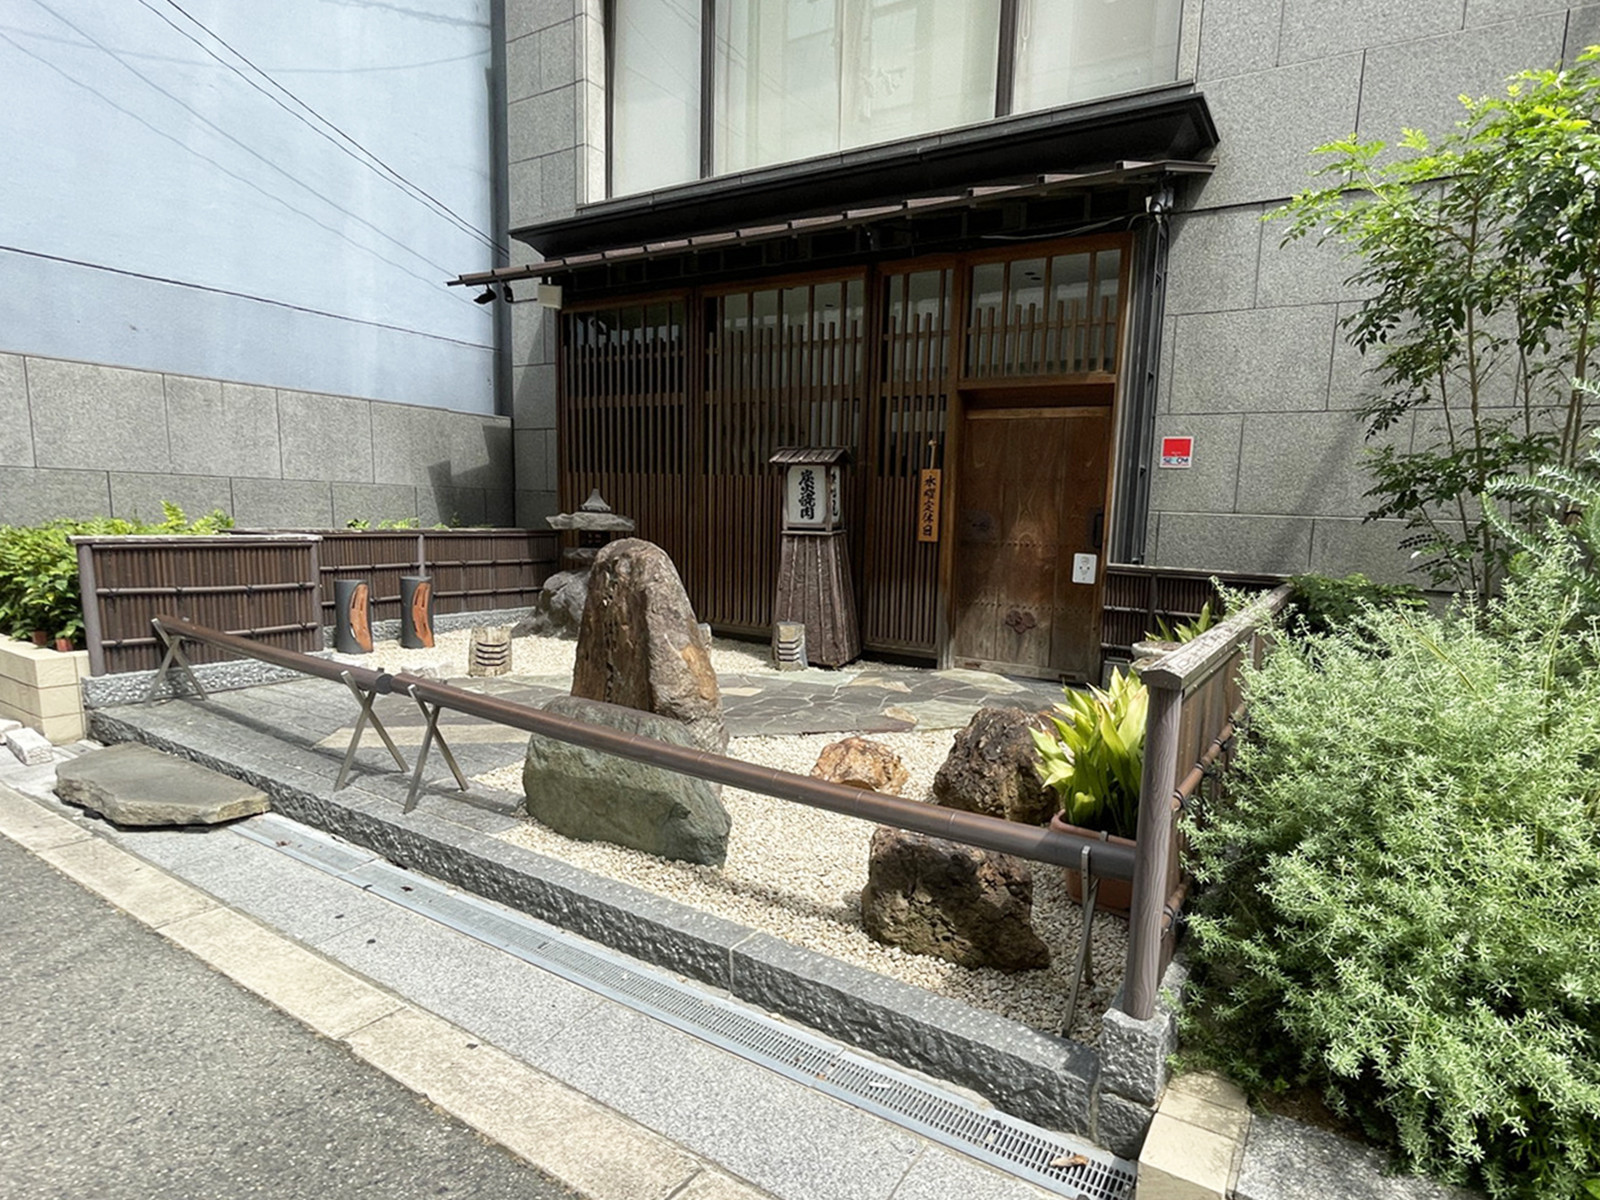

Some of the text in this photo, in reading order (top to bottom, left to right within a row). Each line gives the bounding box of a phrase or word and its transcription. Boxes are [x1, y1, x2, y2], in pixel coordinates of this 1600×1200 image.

[799, 469, 816, 520] 炭火焼肉
[923, 475, 936, 537] 水曜定休日
